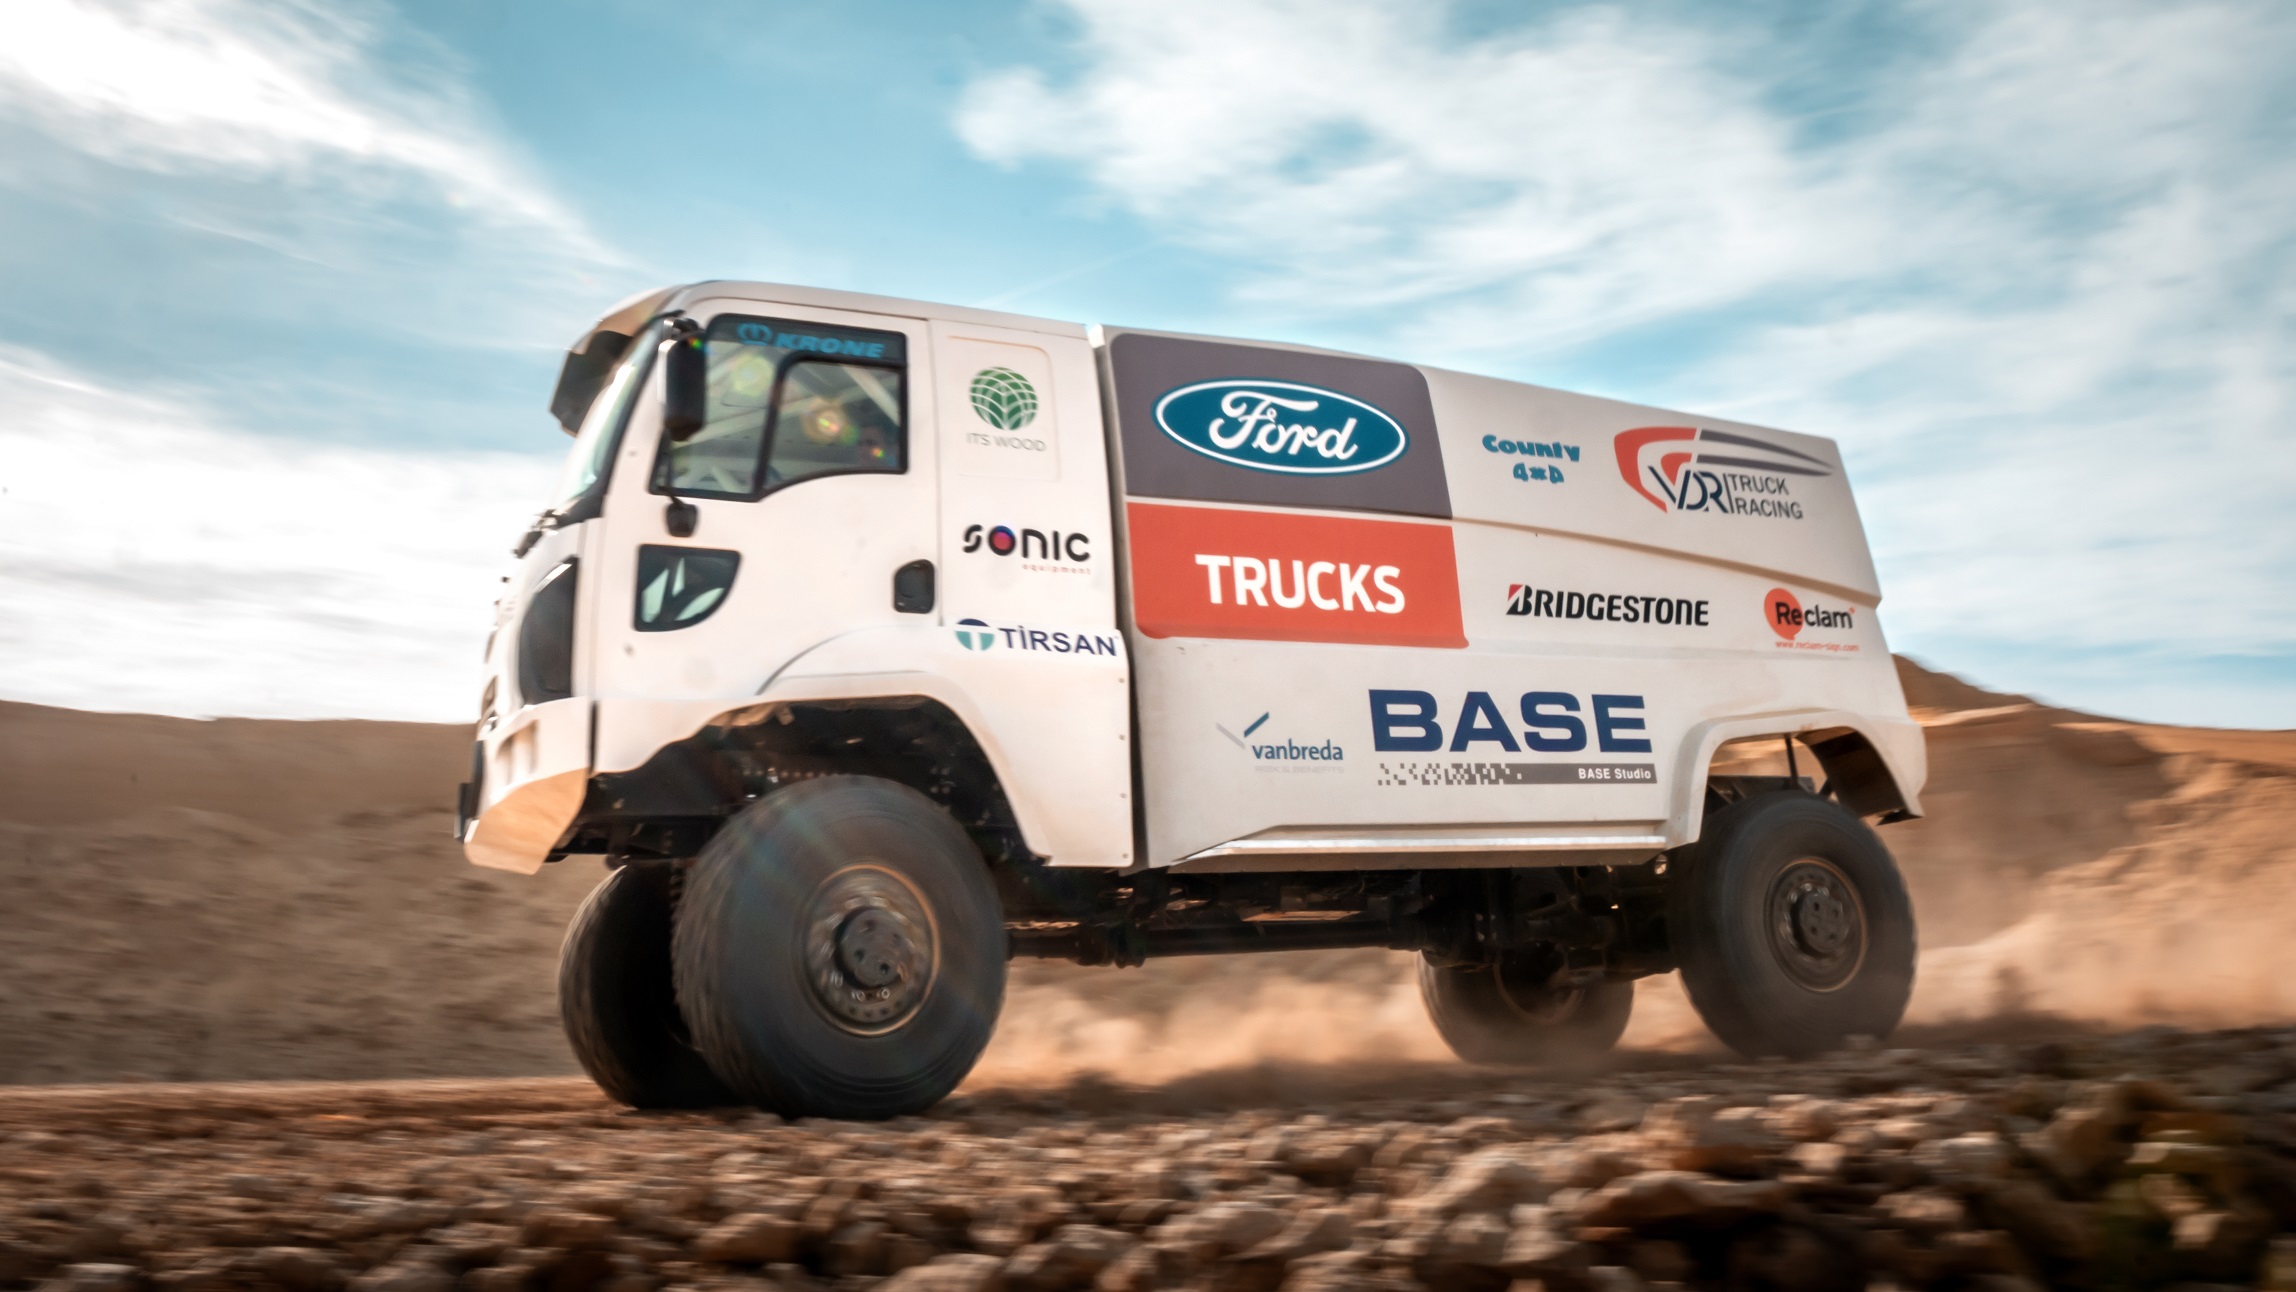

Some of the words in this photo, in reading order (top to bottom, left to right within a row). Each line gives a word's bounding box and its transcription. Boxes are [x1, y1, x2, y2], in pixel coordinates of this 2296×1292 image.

[774, 332, 885, 359] KRONE
[1208, 390, 1359, 460] Ford
[965, 432, 991, 446] ITS
[993, 435, 1047, 452] WOOD
[1648, 465, 1729, 513] VDR
[1727, 474, 1790, 496] TRUCK
[1734, 498, 1804, 520] RACING
[1195, 554, 1406, 614] TRUCKS
[1505, 584, 1710, 627] BRIDGESTONE
[1775, 601, 1854, 629] Reclam
[1368, 689, 1653, 753] BASE
[1251, 738, 1344, 761] vanbreda
[1578, 767, 1611, 779] BASE
[1614, 767, 1652, 779] Studio
